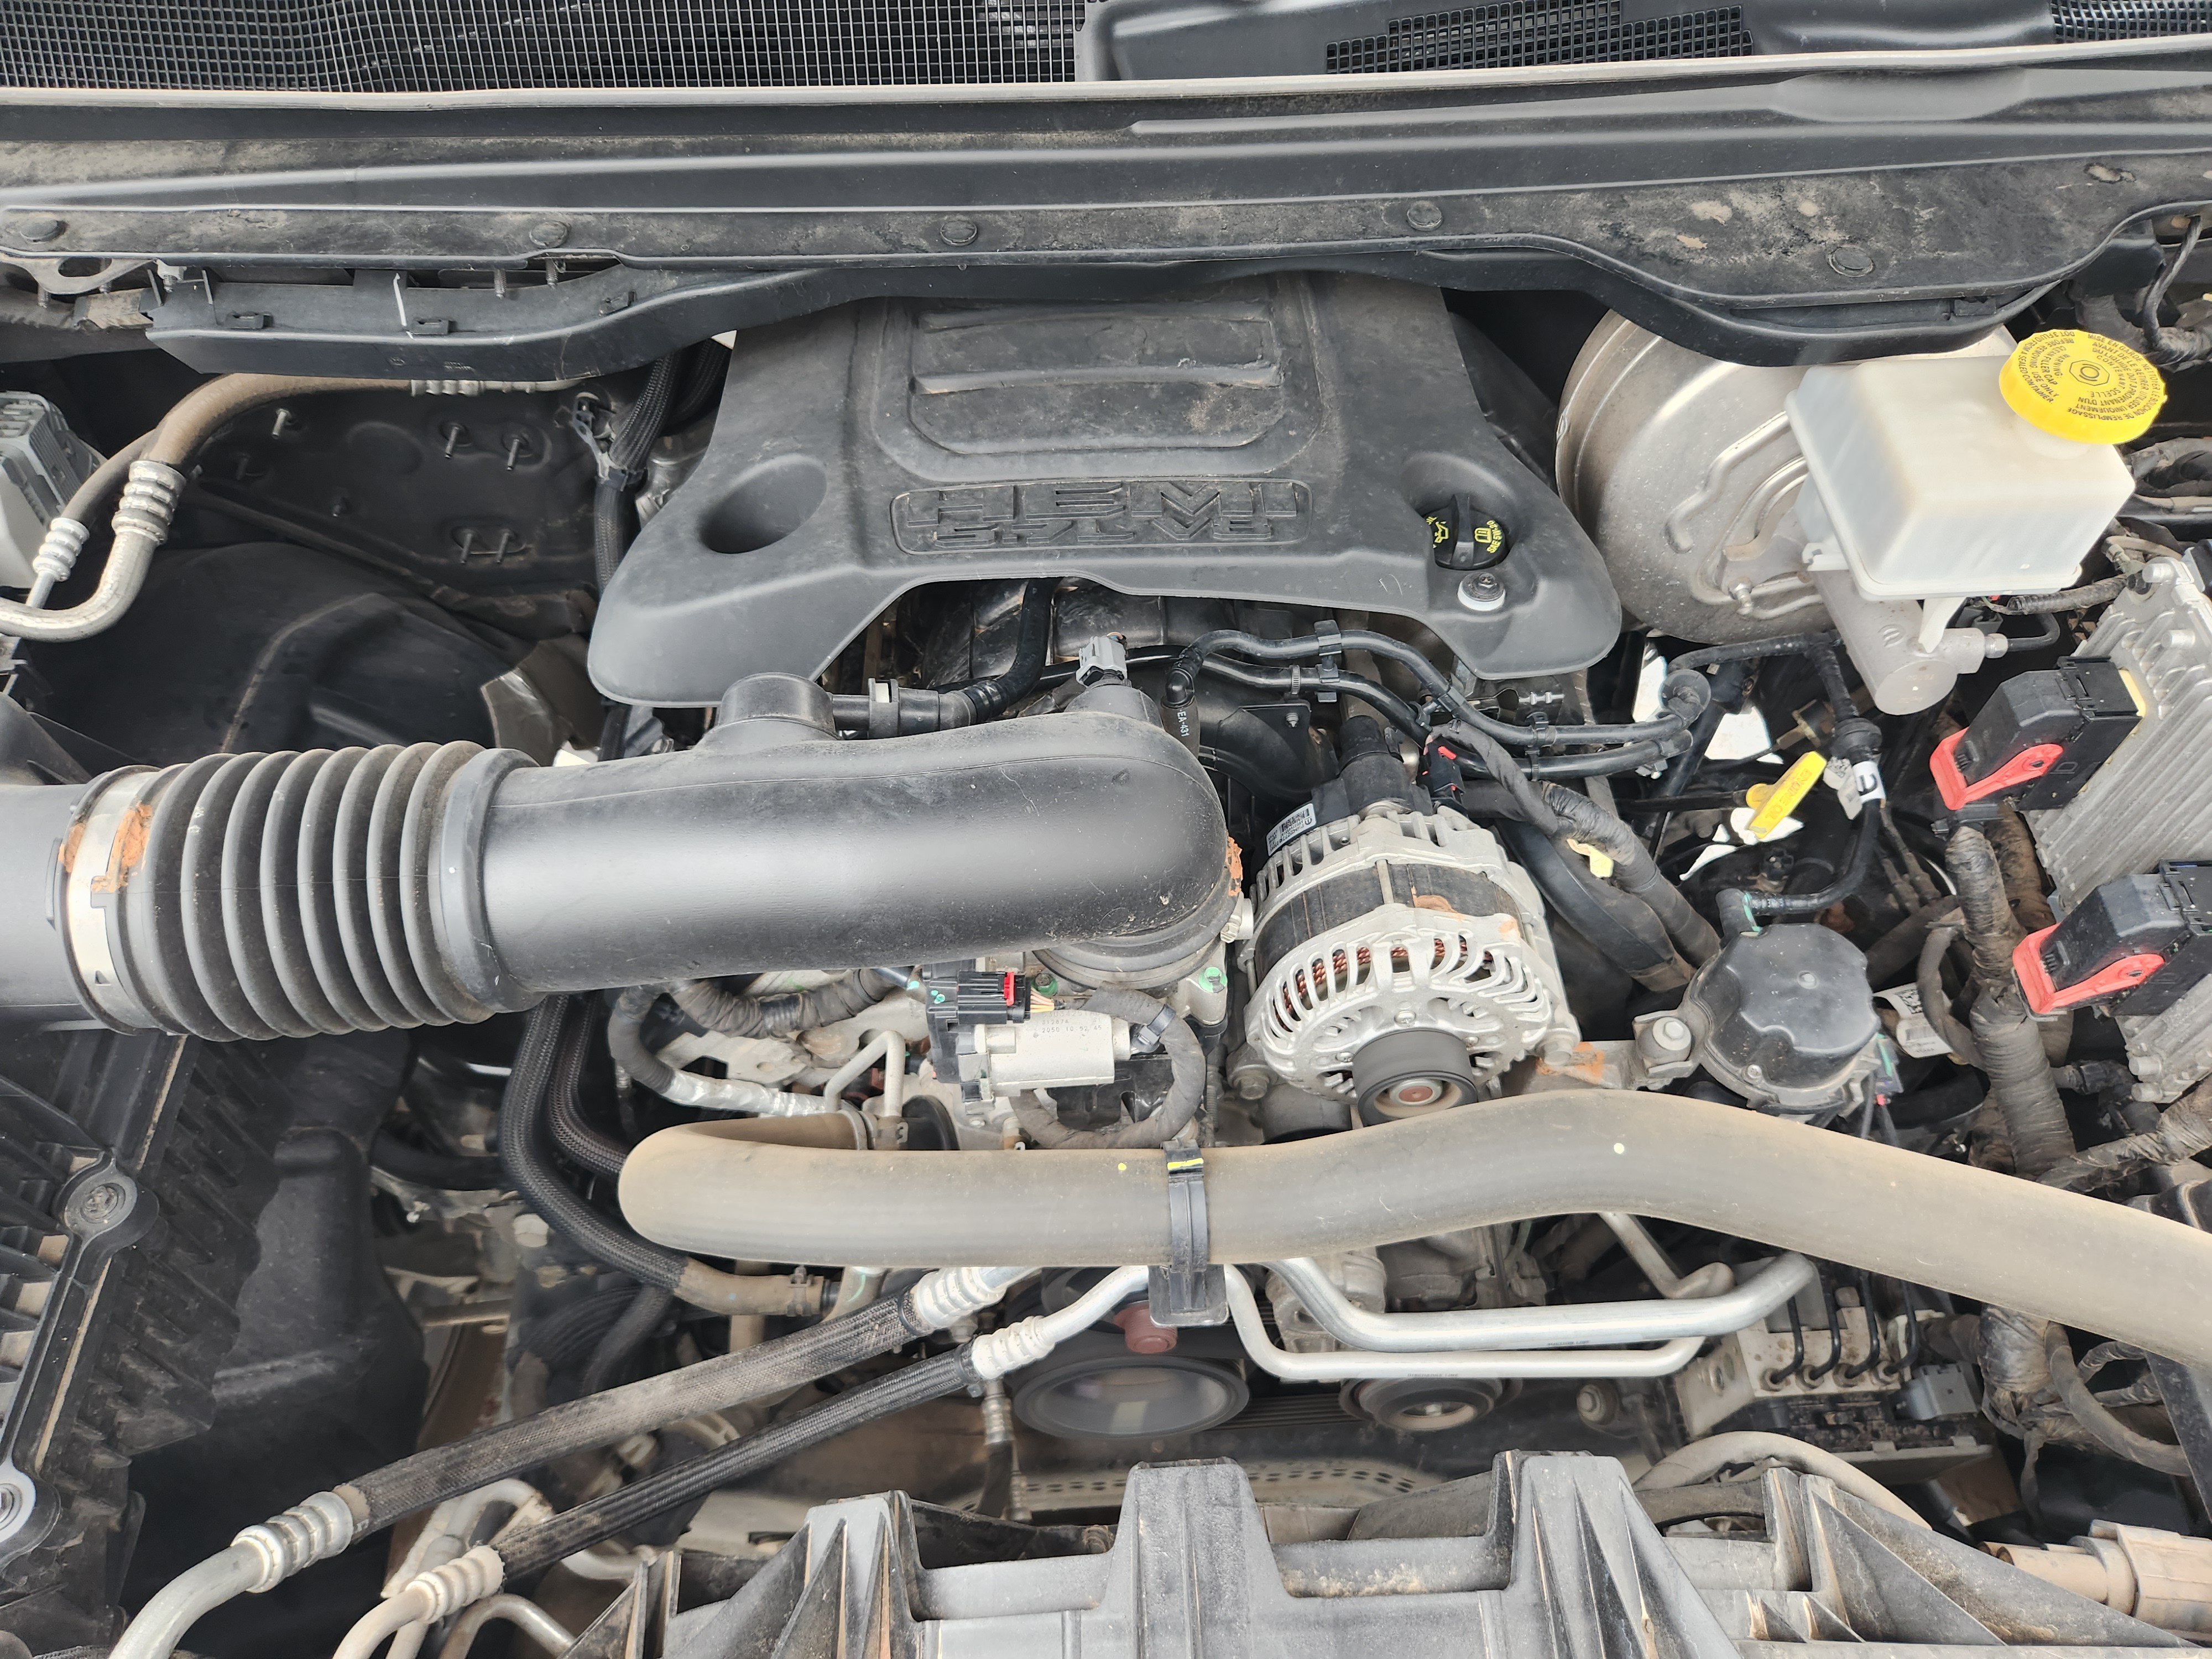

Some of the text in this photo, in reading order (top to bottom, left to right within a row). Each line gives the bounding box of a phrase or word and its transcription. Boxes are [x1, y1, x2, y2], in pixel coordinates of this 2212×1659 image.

[2034, 332, 2054, 342] FLUID
[2045, 338, 2075, 347] BEFORE
[2088, 333, 2105, 342] MISE
[2107, 339, 2119, 347] EN
[2023, 340, 2038, 353] FROM
[2092, 342, 2119, 354] AVANT
[2104, 352, 2131, 372] LIQUIDE
[2118, 352, 2130, 361] DE
[2127, 359, 2136, 368] LE
[2018, 354, 2028, 374] SEALED
[2040, 345, 2067, 385] CLEAN FILLER CAP
[2031, 371, 2044, 382] USE
[2096, 354, 2127, 390] CONTENANT
[2126, 372, 2138, 384] DOT
[2141, 363, 2161, 390] NETTOYER
[2041, 383, 2059, 397] ONLY
[2100, 387, 2137, 406] PROVENANT
[2078, 397, 2098, 405] D'UN
[2127, 391, 2147, 410] UTILISER
[2133, 397, 2158, 416] BOUCHON
[2067, 406, 2124, 421] REMPLISSAGE
[2075, 403, 2128, 414] UNIQUEMENT
[907, 480, 1298, 528] HEMI
[1486, 540, 1502, 554] SAE
[1765, 768, 1813, 820] ENGINE OIL
